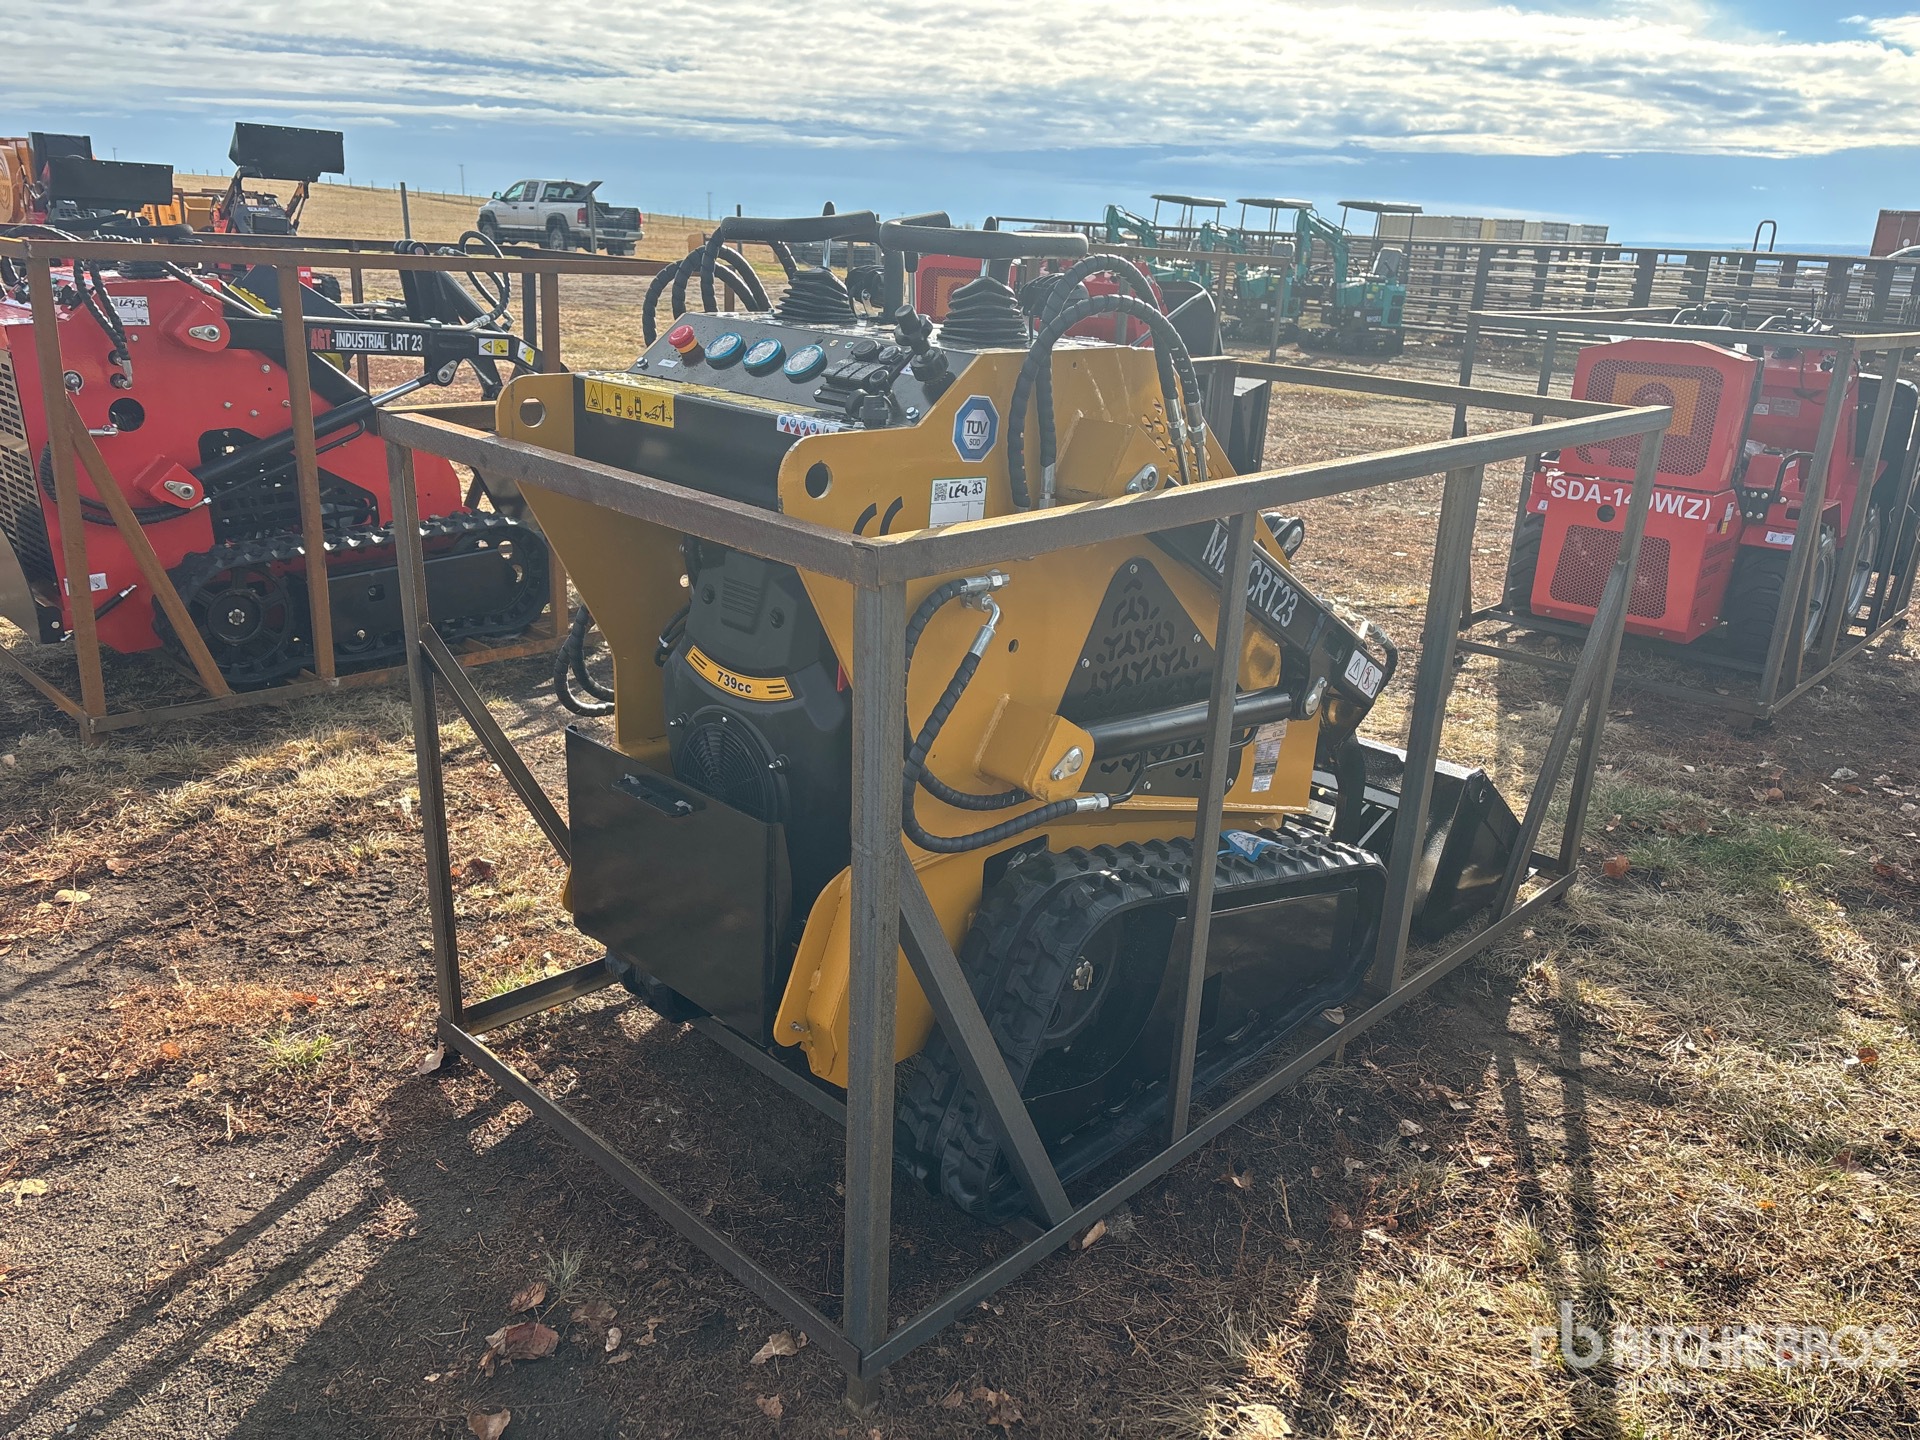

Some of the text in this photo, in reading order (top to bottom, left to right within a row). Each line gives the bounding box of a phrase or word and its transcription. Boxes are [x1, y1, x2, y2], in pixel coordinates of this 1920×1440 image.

[335, 331, 388, 350] INDUSTRIAL
[390, 333, 409, 351] LRT
[411, 334, 423, 351] 23
[966, 420, 988, 435] TÜV
[717, 671, 752, 694] 739cc
